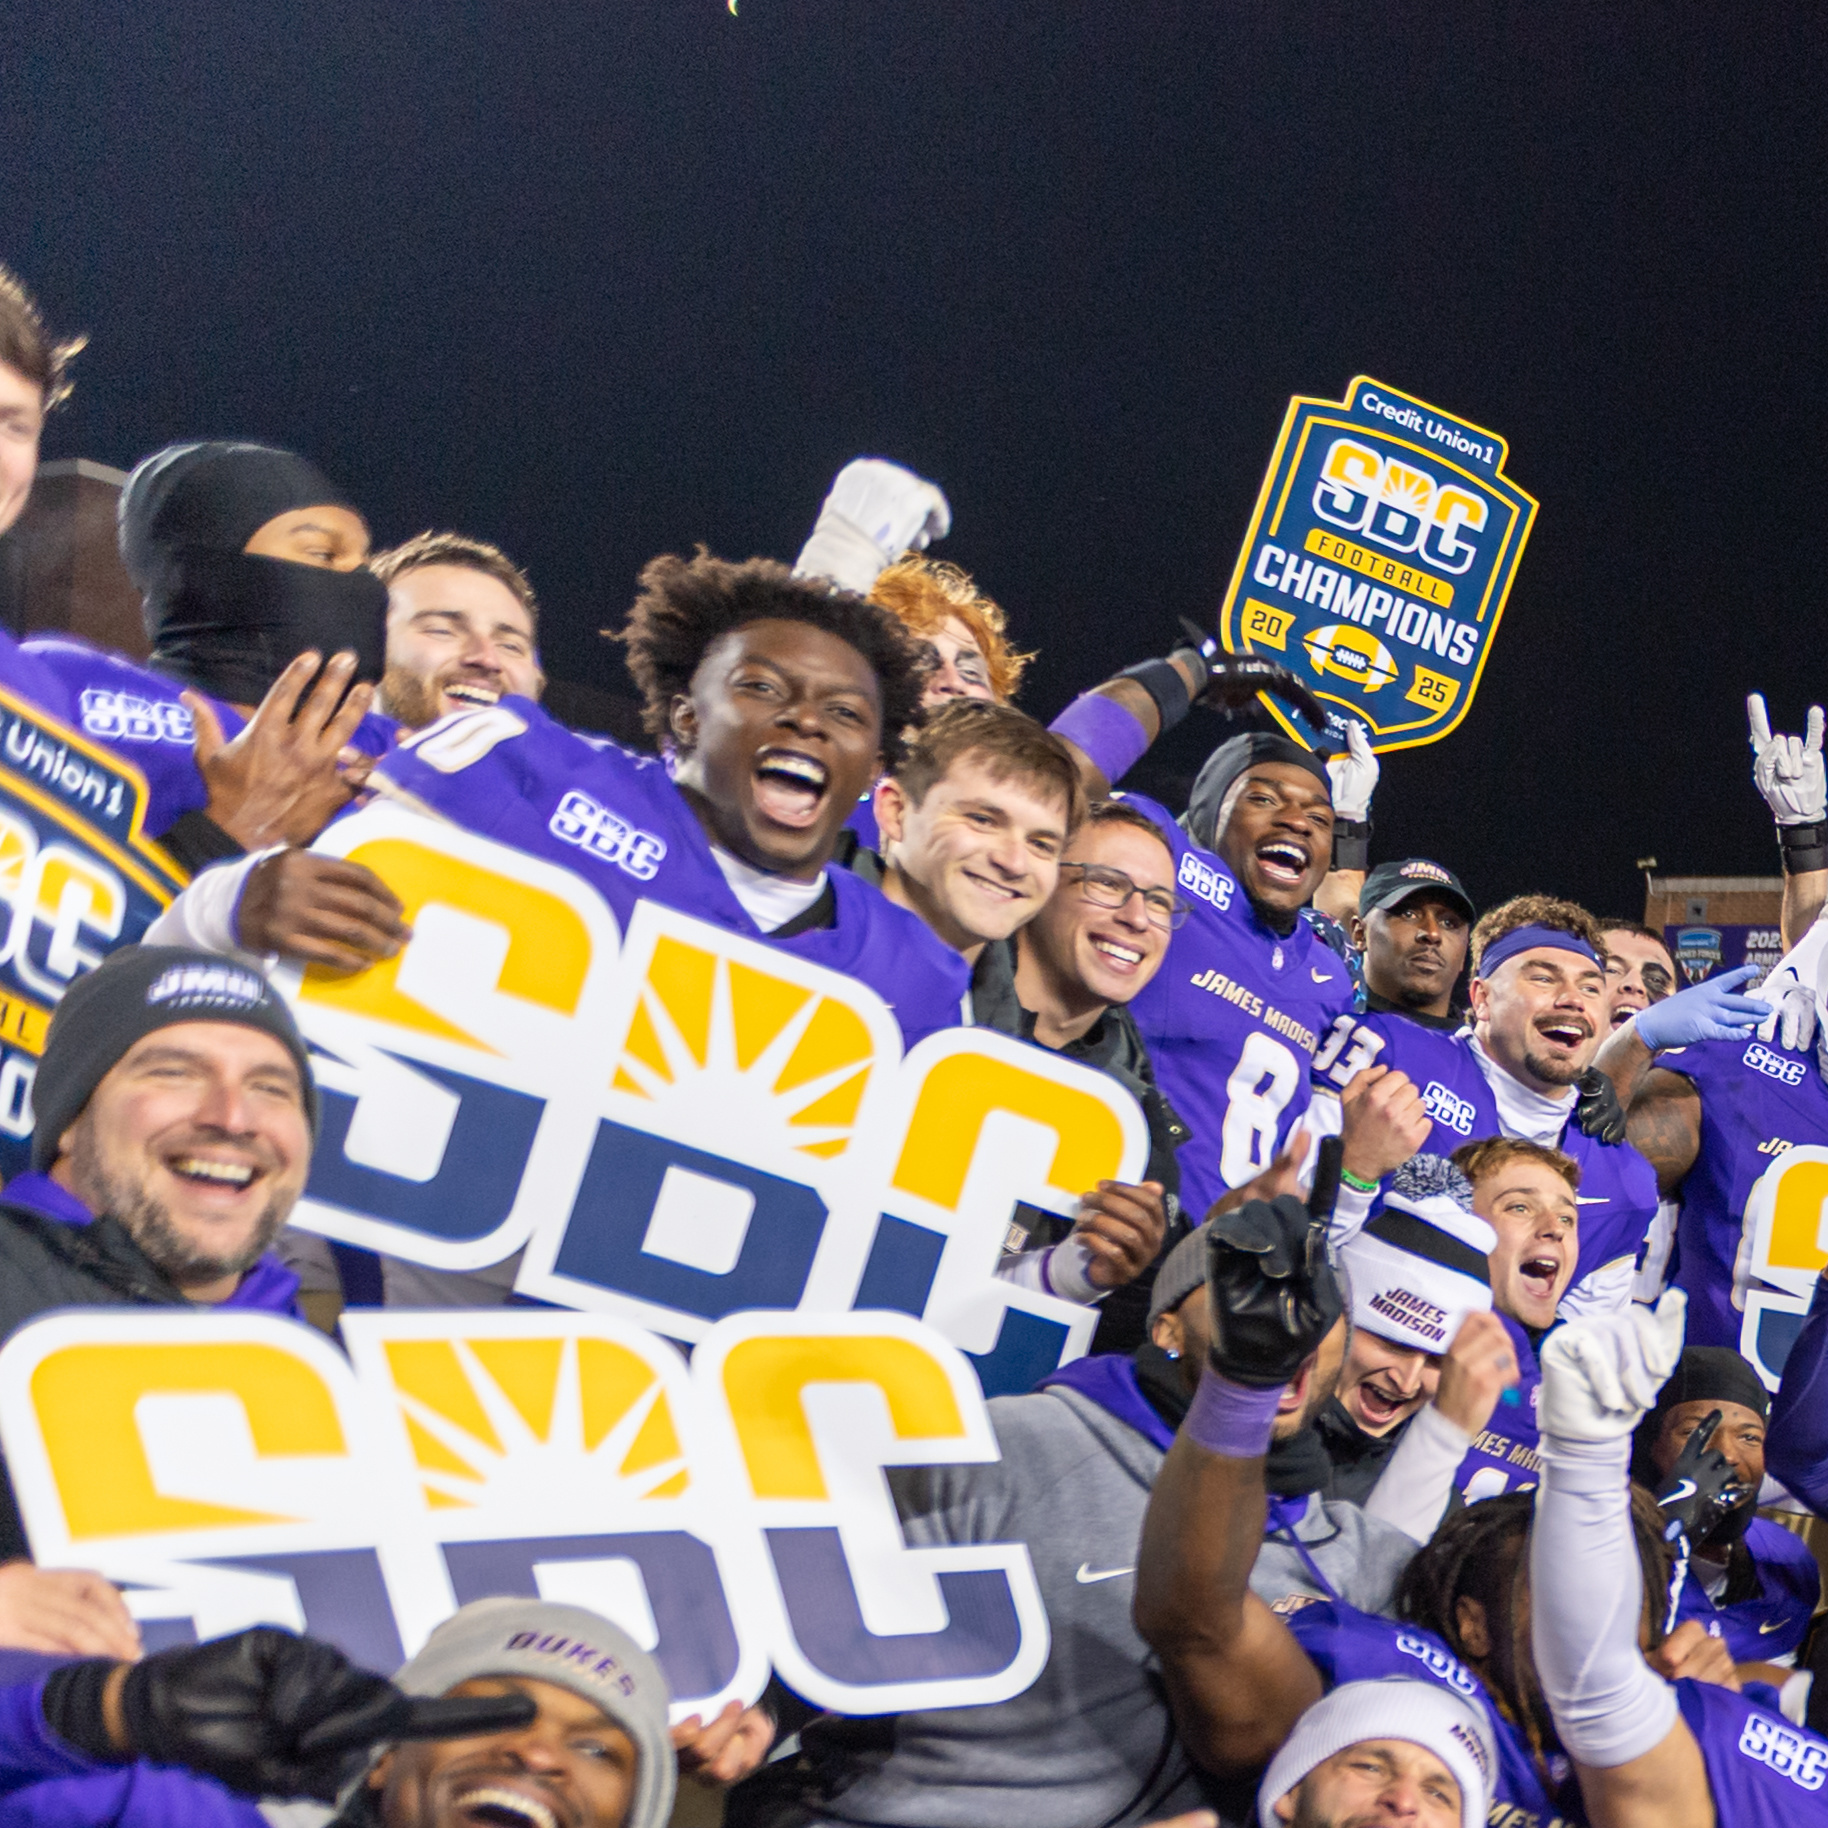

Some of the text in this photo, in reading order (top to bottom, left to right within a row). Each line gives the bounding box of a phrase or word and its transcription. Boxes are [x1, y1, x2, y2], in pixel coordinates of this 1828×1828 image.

[1361, 393, 1495, 465] Credit Union 1
[1312, 438, 1489, 576] SBC
[1317, 536, 1442, 603] FOOTBALL
[1249, 610, 1284, 639] 20
[1254, 543, 1479, 666] CHAMPIONS
[1417, 676, 1449, 704] 25
[6, 718, 108, 802] Union
[548, 791, 669, 882] SBC
[1176, 852, 1236, 911] SBC
[146, 962, 265, 1005] JMU
[1190, 968, 1319, 1054] JAMES MADIS
[1315, 1014, 1387, 1087] 33
[1742, 1041, 1807, 1087] SBC
[1219, 1030, 1301, 1190] 8
[1421, 1081, 1477, 1137] SBC
[1368, 1293, 1448, 1344] MADISON
[1383, 1286, 1449, 1327] JAMES
[1472, 1429, 1511, 1458] MES
[504, 1629, 637, 1700] DUKES
